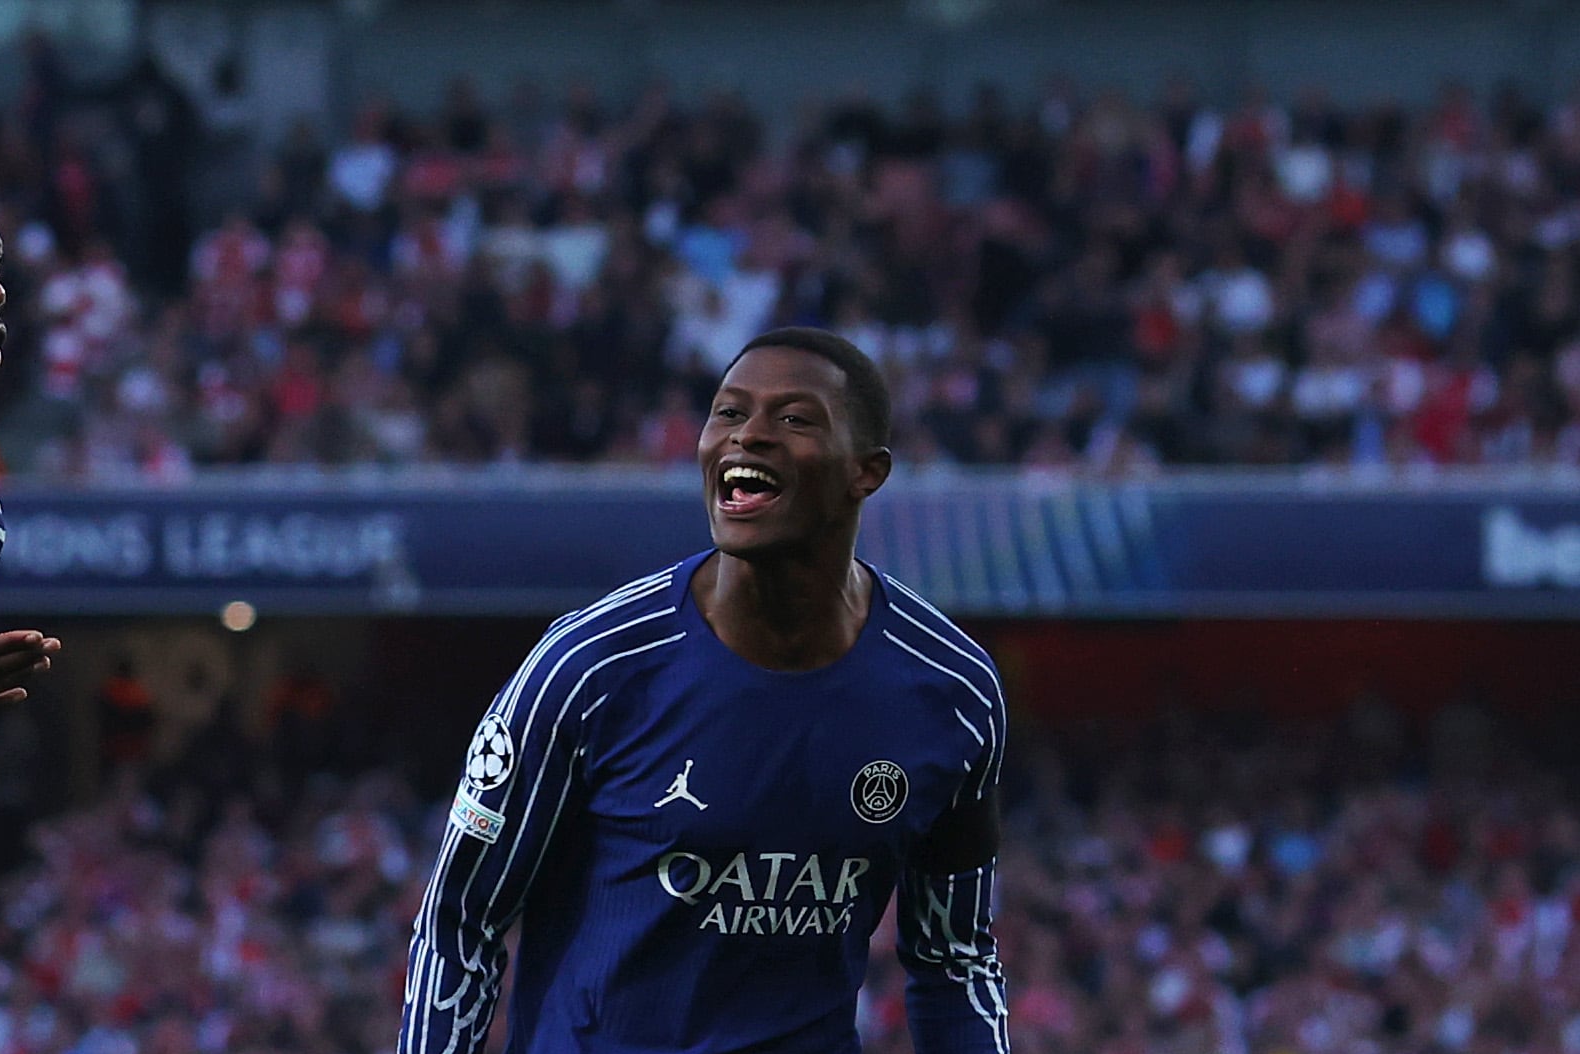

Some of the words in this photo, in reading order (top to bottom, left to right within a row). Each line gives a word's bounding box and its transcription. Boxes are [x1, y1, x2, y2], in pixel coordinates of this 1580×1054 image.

[863, 763, 901, 780] PARIS
[658, 851, 870, 905] QATAR
[699, 902, 855, 936] AIRWAYS
